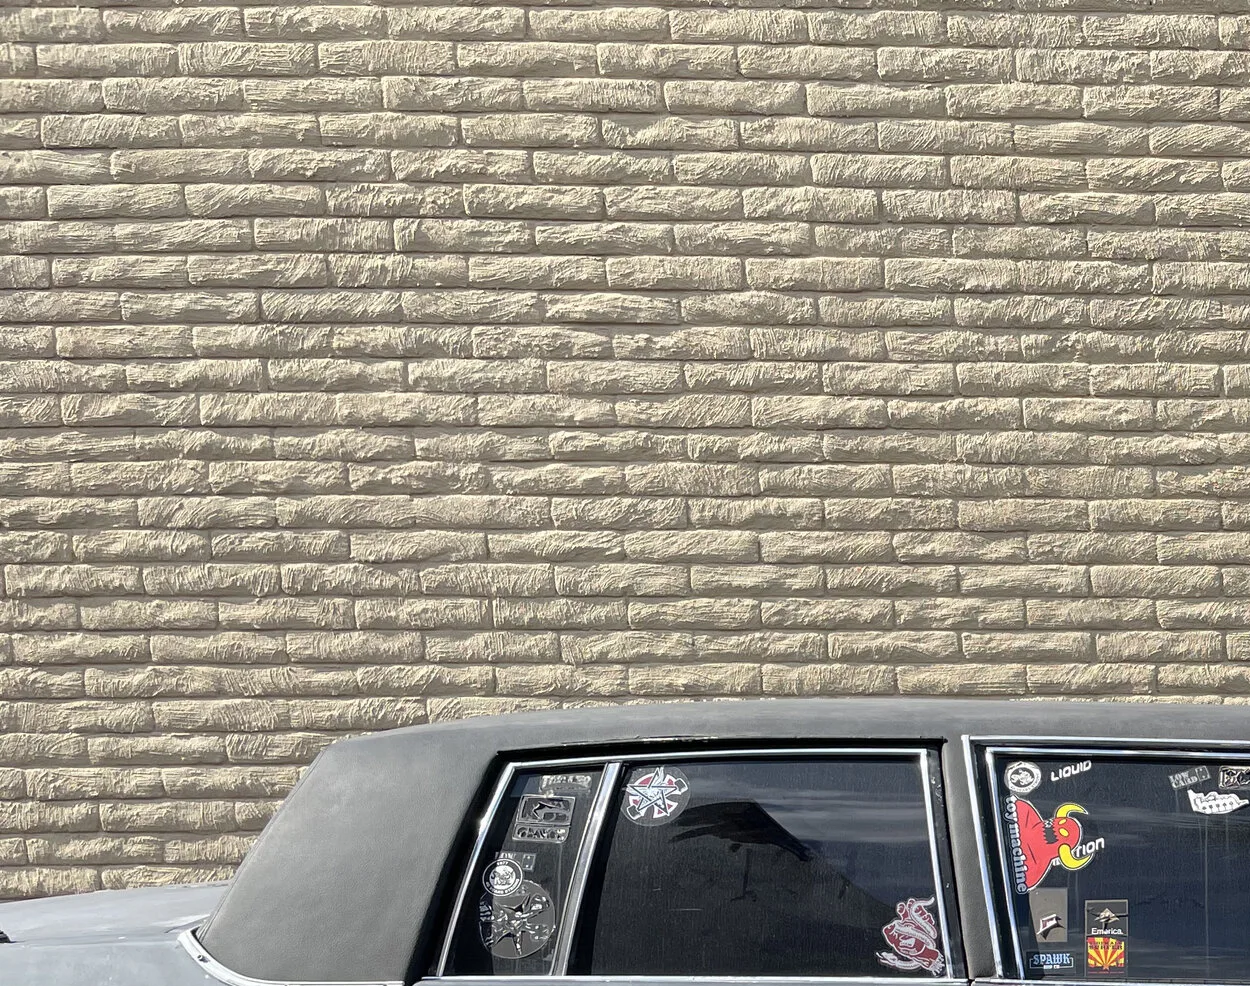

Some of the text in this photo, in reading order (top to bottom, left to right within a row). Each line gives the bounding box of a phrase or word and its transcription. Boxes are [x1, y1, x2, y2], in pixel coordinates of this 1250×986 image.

[1051, 760, 1092, 782] LIQUID
[1168, 770, 1189, 783] LOW
[1172, 775, 1199, 789] CARD
[1005, 795, 1028, 893] toymachine
